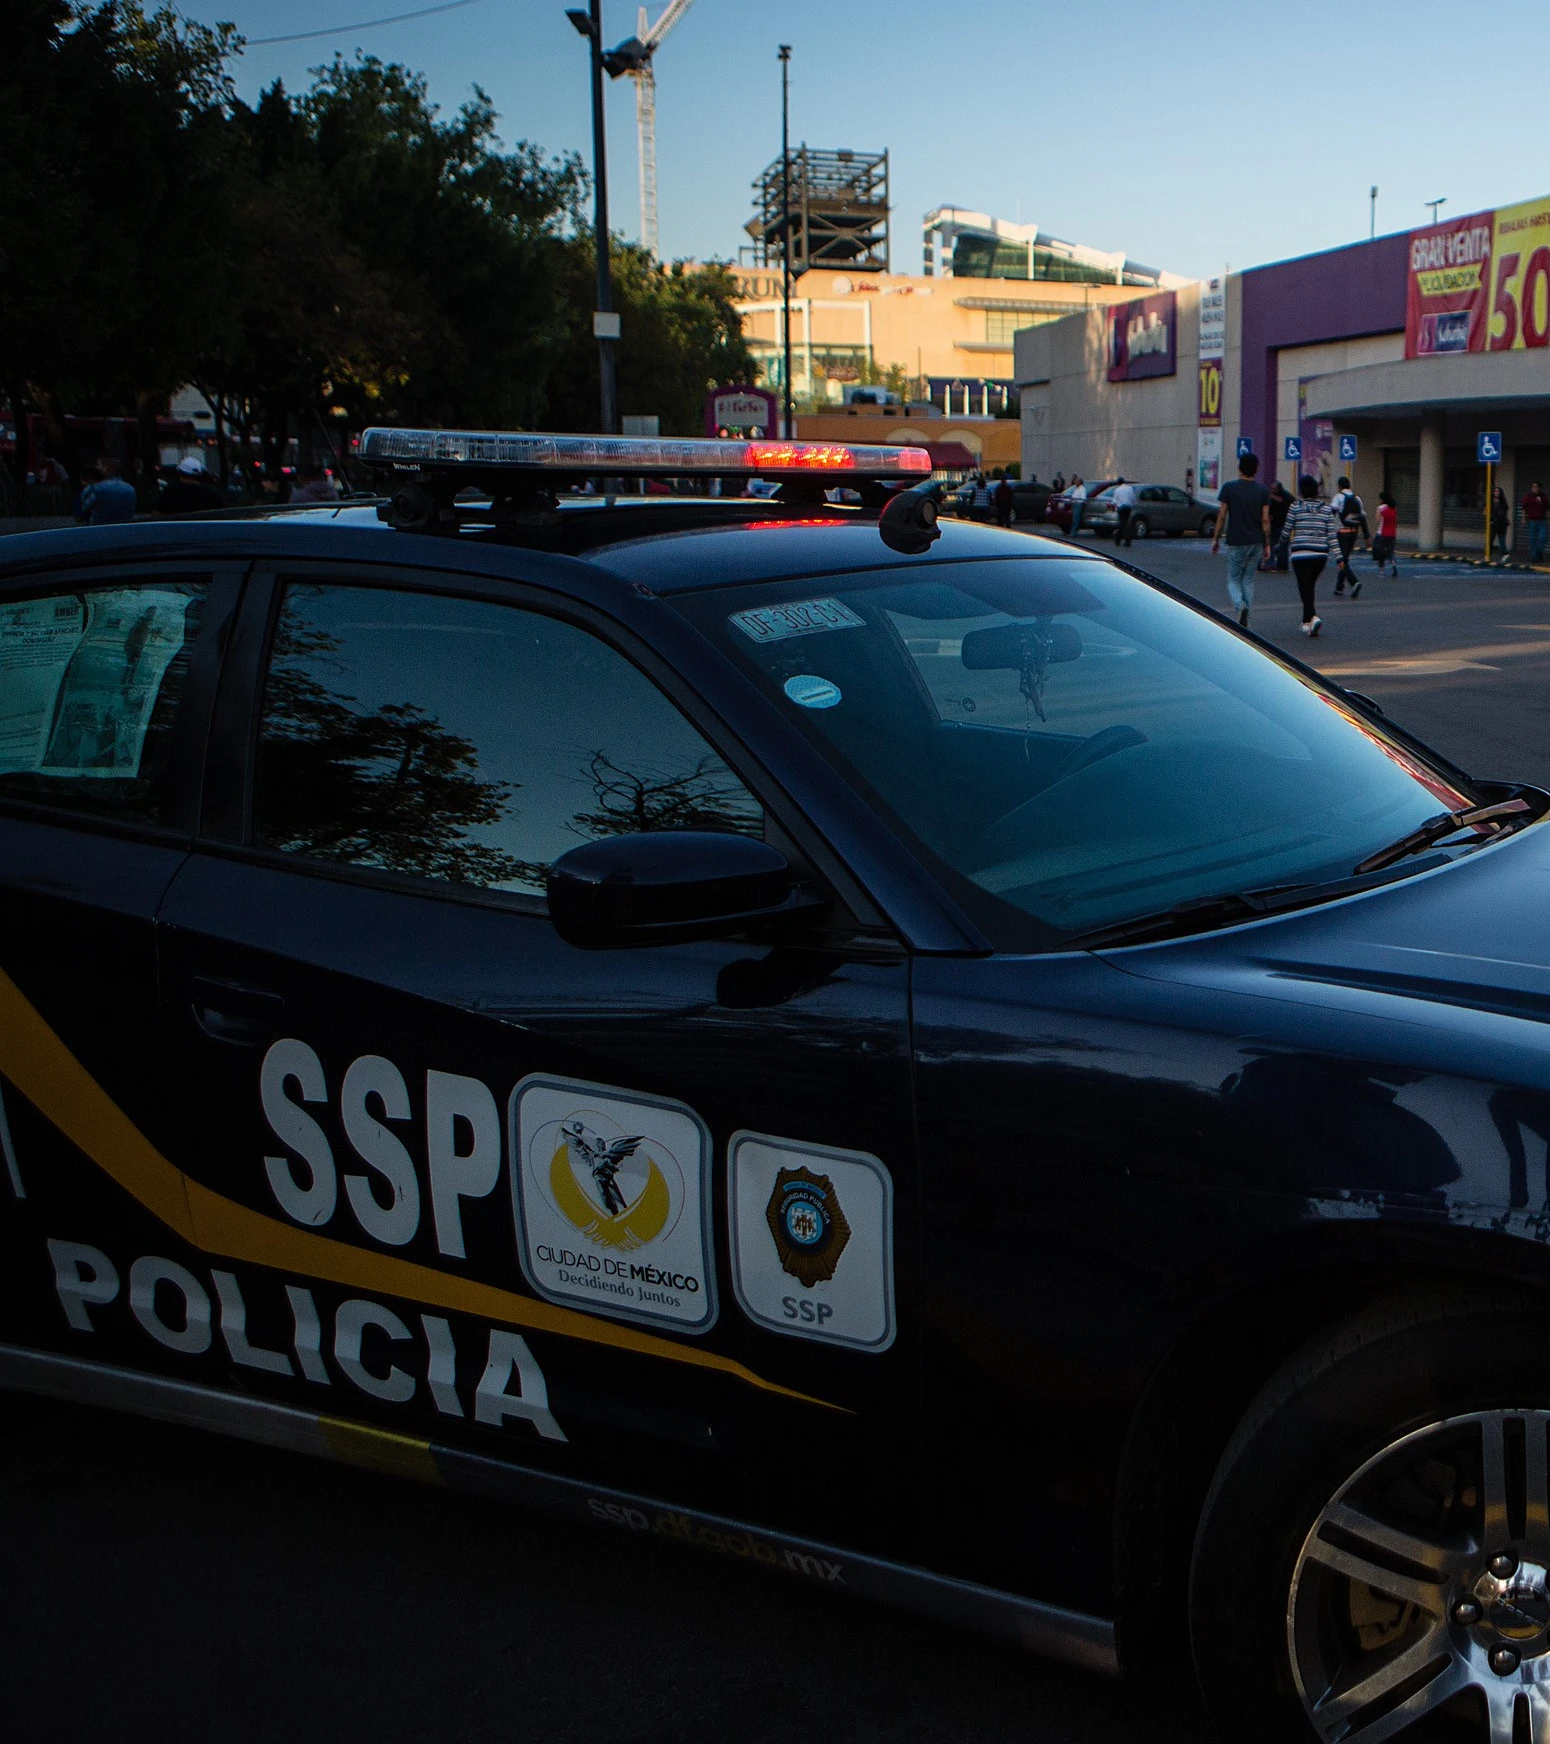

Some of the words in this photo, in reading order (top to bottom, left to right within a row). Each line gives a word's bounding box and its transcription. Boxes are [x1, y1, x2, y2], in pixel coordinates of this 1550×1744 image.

[1446, 226, 1491, 264] VENTA
[741, 604, 850, 636] DF-302-C1
[259, 1037, 503, 1259] SSP
[780, 1192, 808, 1214] SEGURIDAD
[536, 1245, 601, 1273] CIUDAD
[604, 1258, 628, 1279] DE
[629, 1262, 699, 1293] MÉXICO
[559, 1268, 634, 1297] Decidiendo
[639, 1286, 681, 1308] Juntos
[783, 1296, 833, 1325] SSP
[45, 1237, 570, 1443] POLICIA
[586, 1497, 849, 1585] ssp.df.gob.mx
